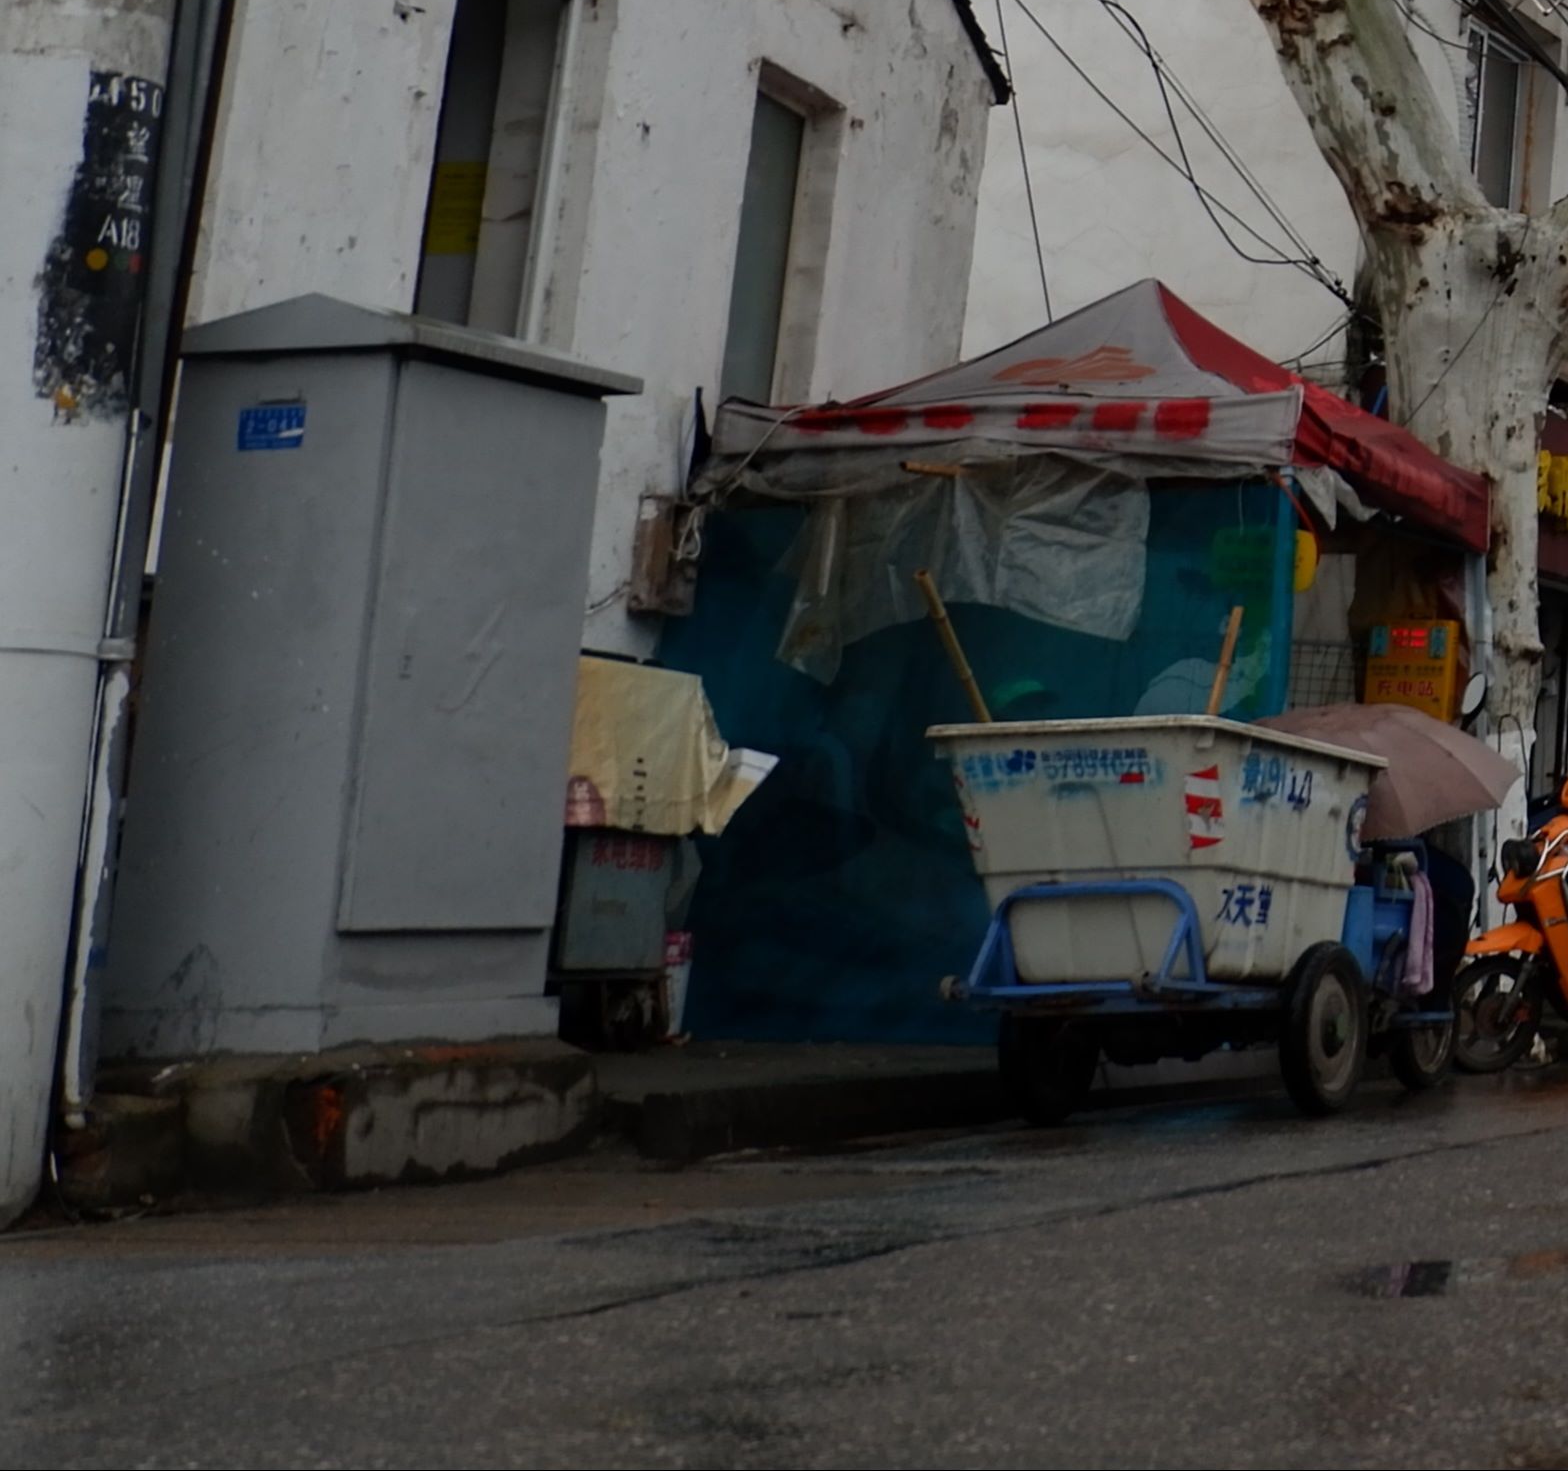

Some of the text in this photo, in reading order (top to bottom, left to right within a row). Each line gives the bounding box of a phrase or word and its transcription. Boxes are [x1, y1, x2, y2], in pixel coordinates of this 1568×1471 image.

[97, 213, 141, 251] A18
[1377, 679, 1434, 697] 充电站
